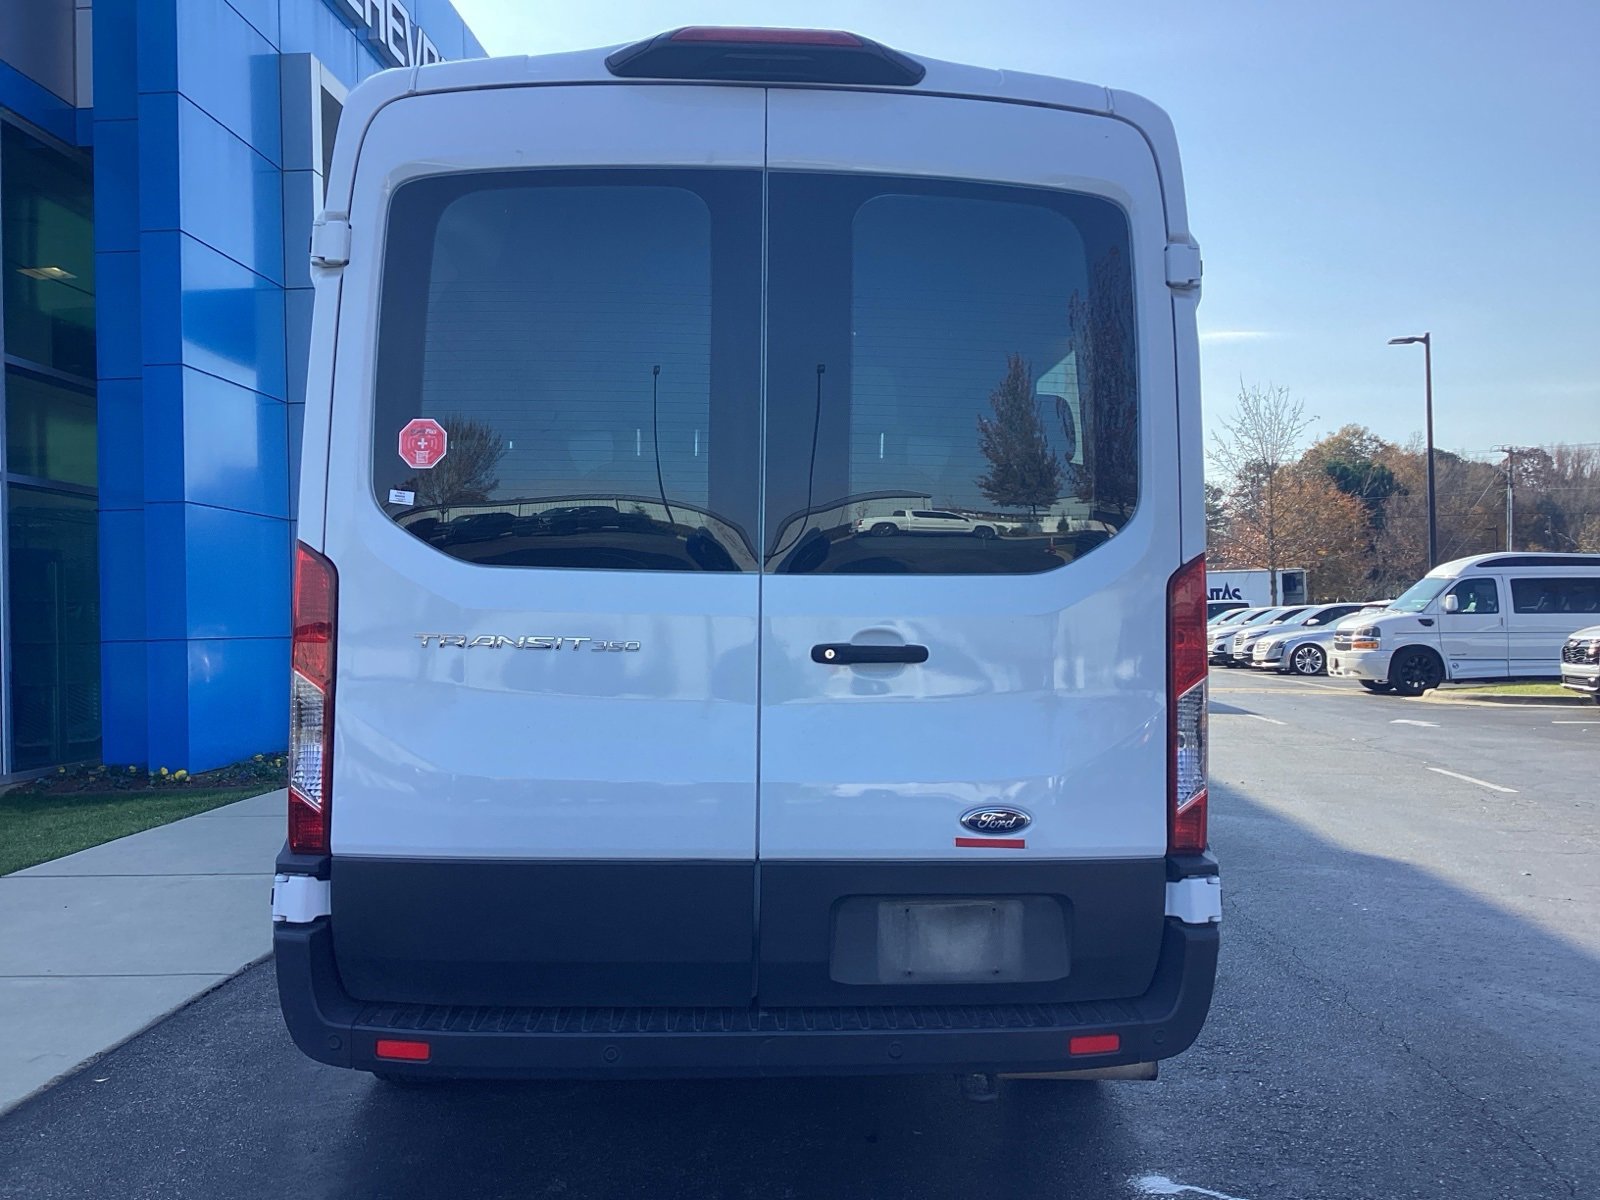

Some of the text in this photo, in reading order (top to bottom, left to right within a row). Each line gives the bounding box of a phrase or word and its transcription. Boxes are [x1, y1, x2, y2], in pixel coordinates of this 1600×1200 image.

[346, 0, 447, 67] HEV
[414, 633, 641, 652] TRANSIT 350
[977, 812, 1017, 828] Ford
